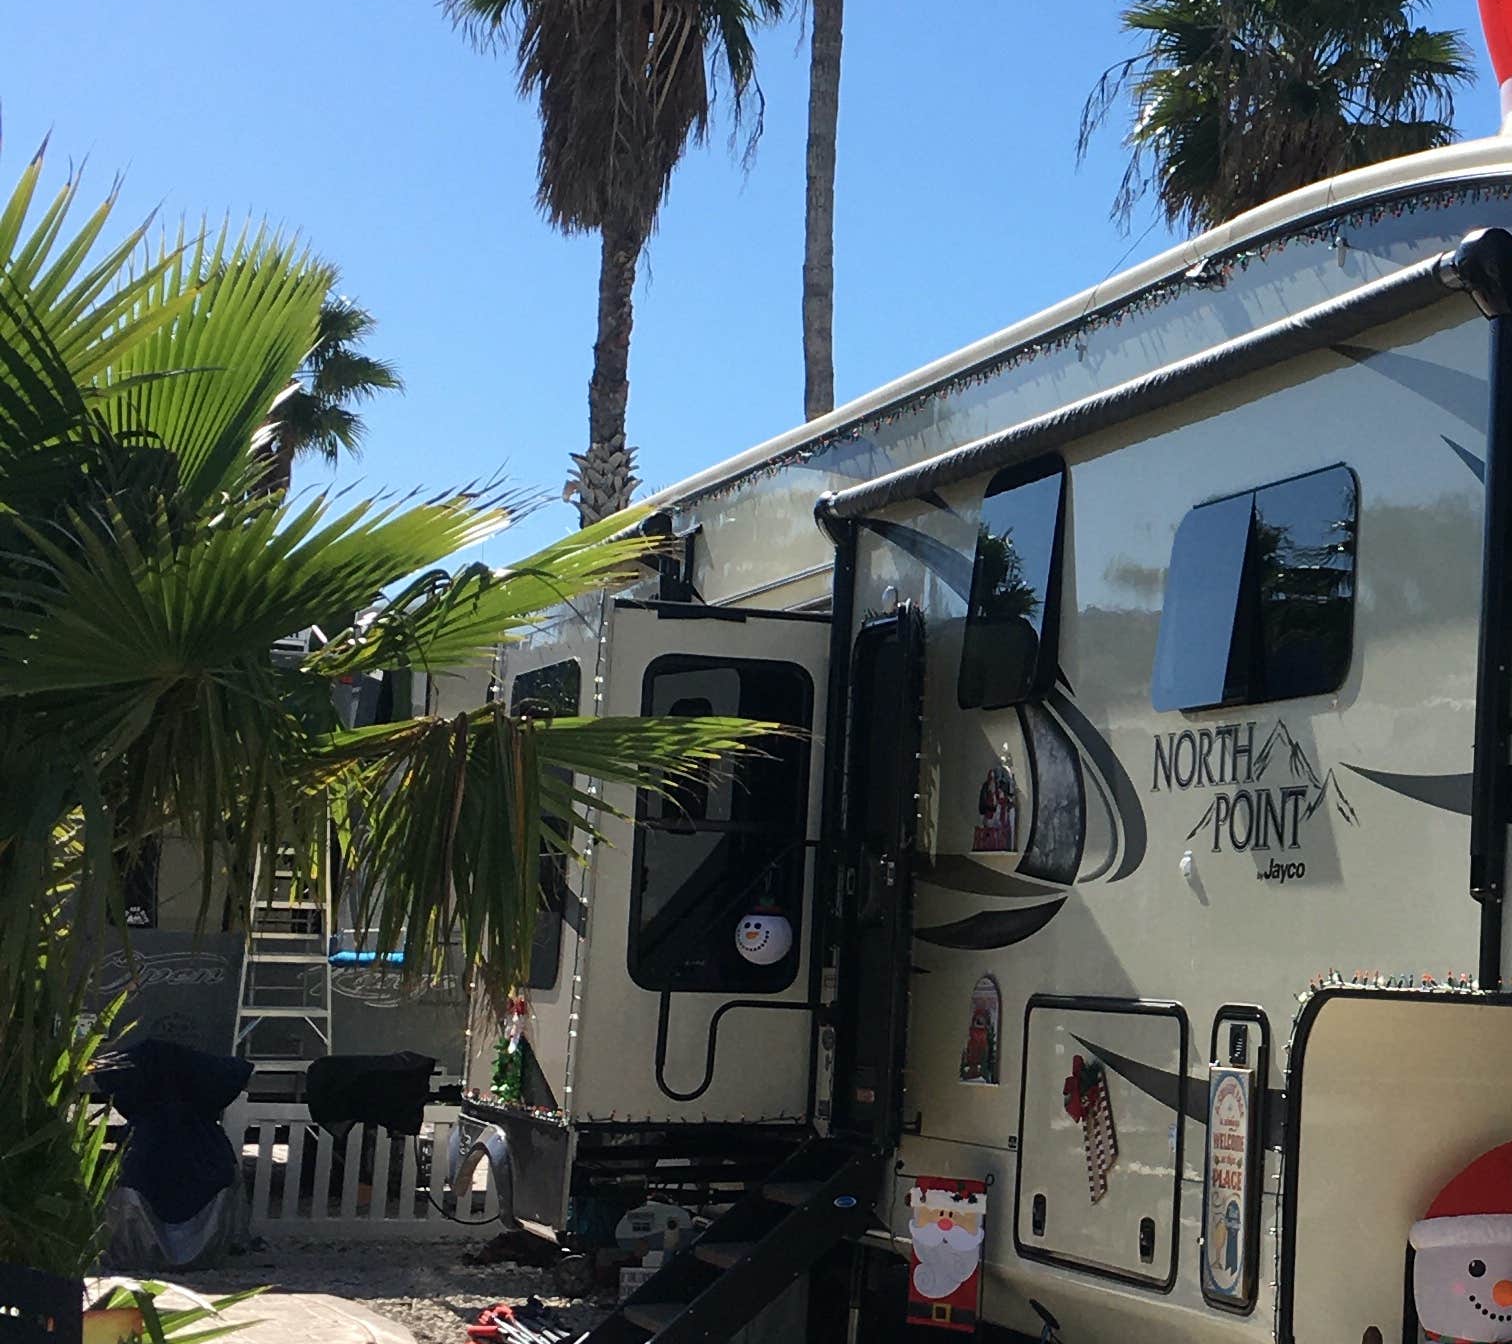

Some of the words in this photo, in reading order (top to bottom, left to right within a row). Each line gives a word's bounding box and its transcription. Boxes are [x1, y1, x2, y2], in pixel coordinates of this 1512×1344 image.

[1150, 721, 1257, 792] NORTH
[1211, 785, 1309, 853] POINT
[1264, 858, 1306, 884] Jayco
[1213, 1133, 1244, 1152] WELCOME
[1212, 1168, 1242, 1191] PLACE
